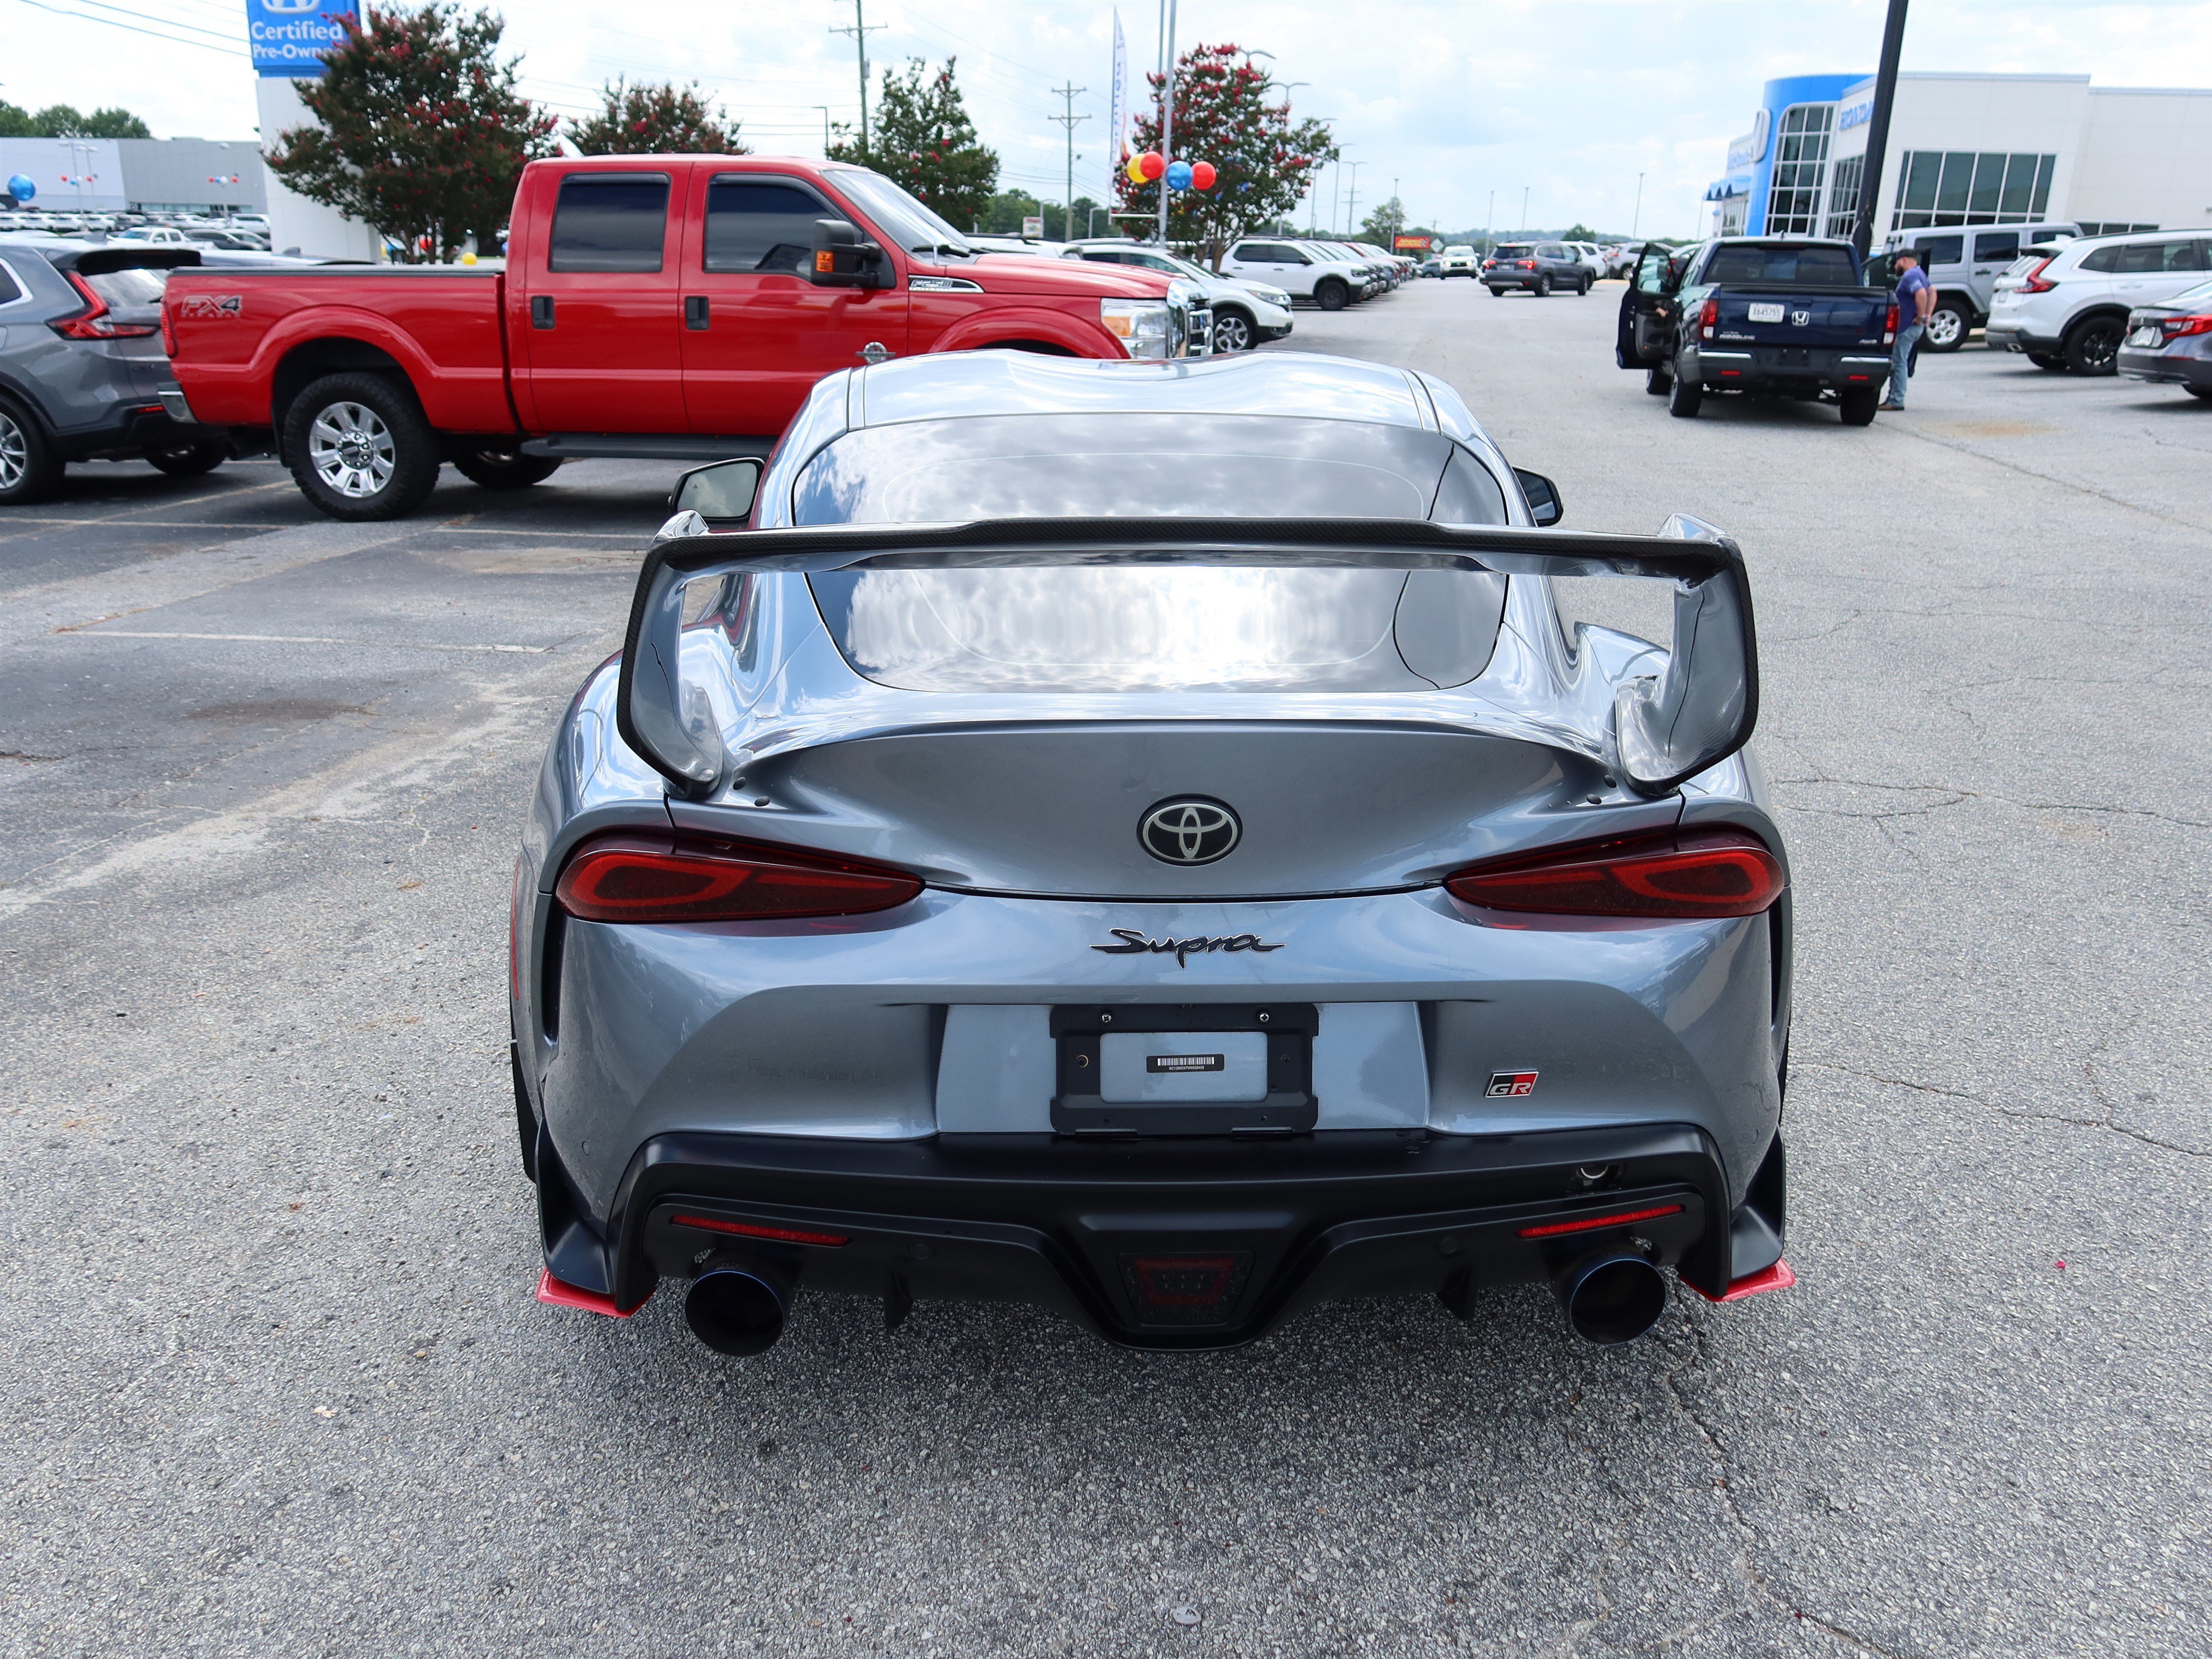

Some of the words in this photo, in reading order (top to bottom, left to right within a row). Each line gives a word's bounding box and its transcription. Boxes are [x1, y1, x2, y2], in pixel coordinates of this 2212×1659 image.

[251, 21, 344, 41] Certified
[181, 295, 242, 313] FX4
[1089, 928, 1287, 970] Supra
[1489, 1082, 1532, 1095] GR
